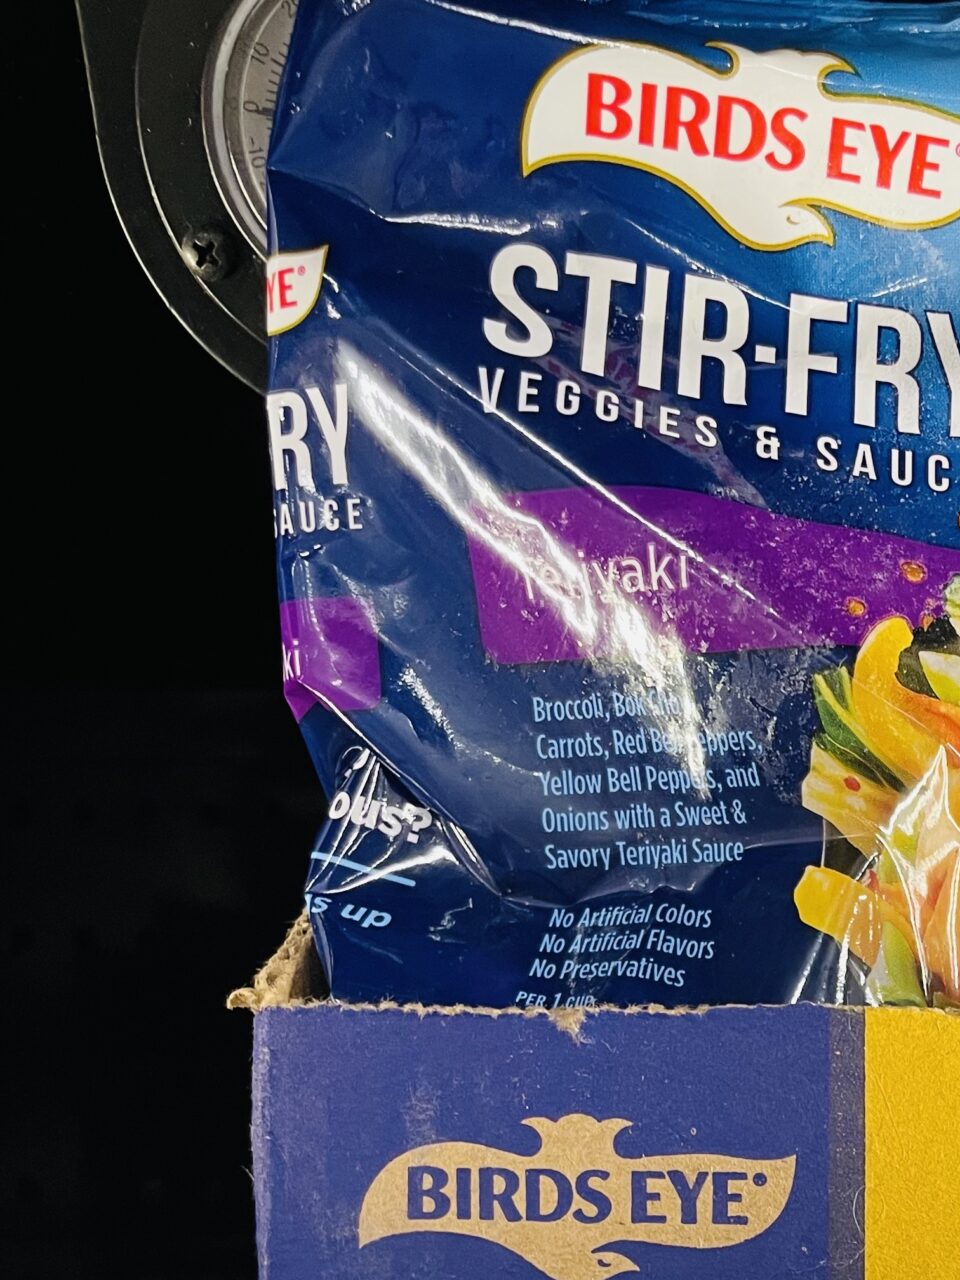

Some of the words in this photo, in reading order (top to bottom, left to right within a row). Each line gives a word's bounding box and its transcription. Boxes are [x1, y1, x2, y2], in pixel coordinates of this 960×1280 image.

[584, 70, 806, 173] BIRDS
[478, 365, 720, 448] VEGGIES
[756, 427, 781, 461] &
[533, 692, 610, 723] Broccoli,
[612, 691, 647, 718] Bok
[648, 689, 685, 717] Cho
[536, 734, 610, 760] Carrots,
[613, 727, 647, 754] Red
[688, 729, 763, 758] eppers,
[540, 770, 602, 796] Yellow
[607, 765, 642, 794] Bell
[646, 767, 722, 795] Pepps,
[726, 761, 761, 788] and
[541, 804, 610, 834] Onions
[615, 802, 657, 831] with
[659, 808, 671, 828] a
[674, 799, 729, 828] Sweet
[732, 802, 747, 826] &
[544, 842, 611, 874] Savory
[615, 839, 688, 870] Teriyaki
[691, 839, 744, 867] Sauce
[339, 903, 393, 929] up
[548, 908, 575, 928] No
[577, 904, 653, 929] Artificial
[655, 902, 713, 929] Colors
[539, 932, 565, 954] No
[568, 929, 645, 954] Artificial
[647, 928, 715, 960] Flavors
[528, 957, 556, 980] No
[559, 957, 686, 988] Preservatives
[515, 990, 548, 1009] PER
[552, 992, 562, 1009] 1
[407, 1164, 611, 1228] BIRDS
